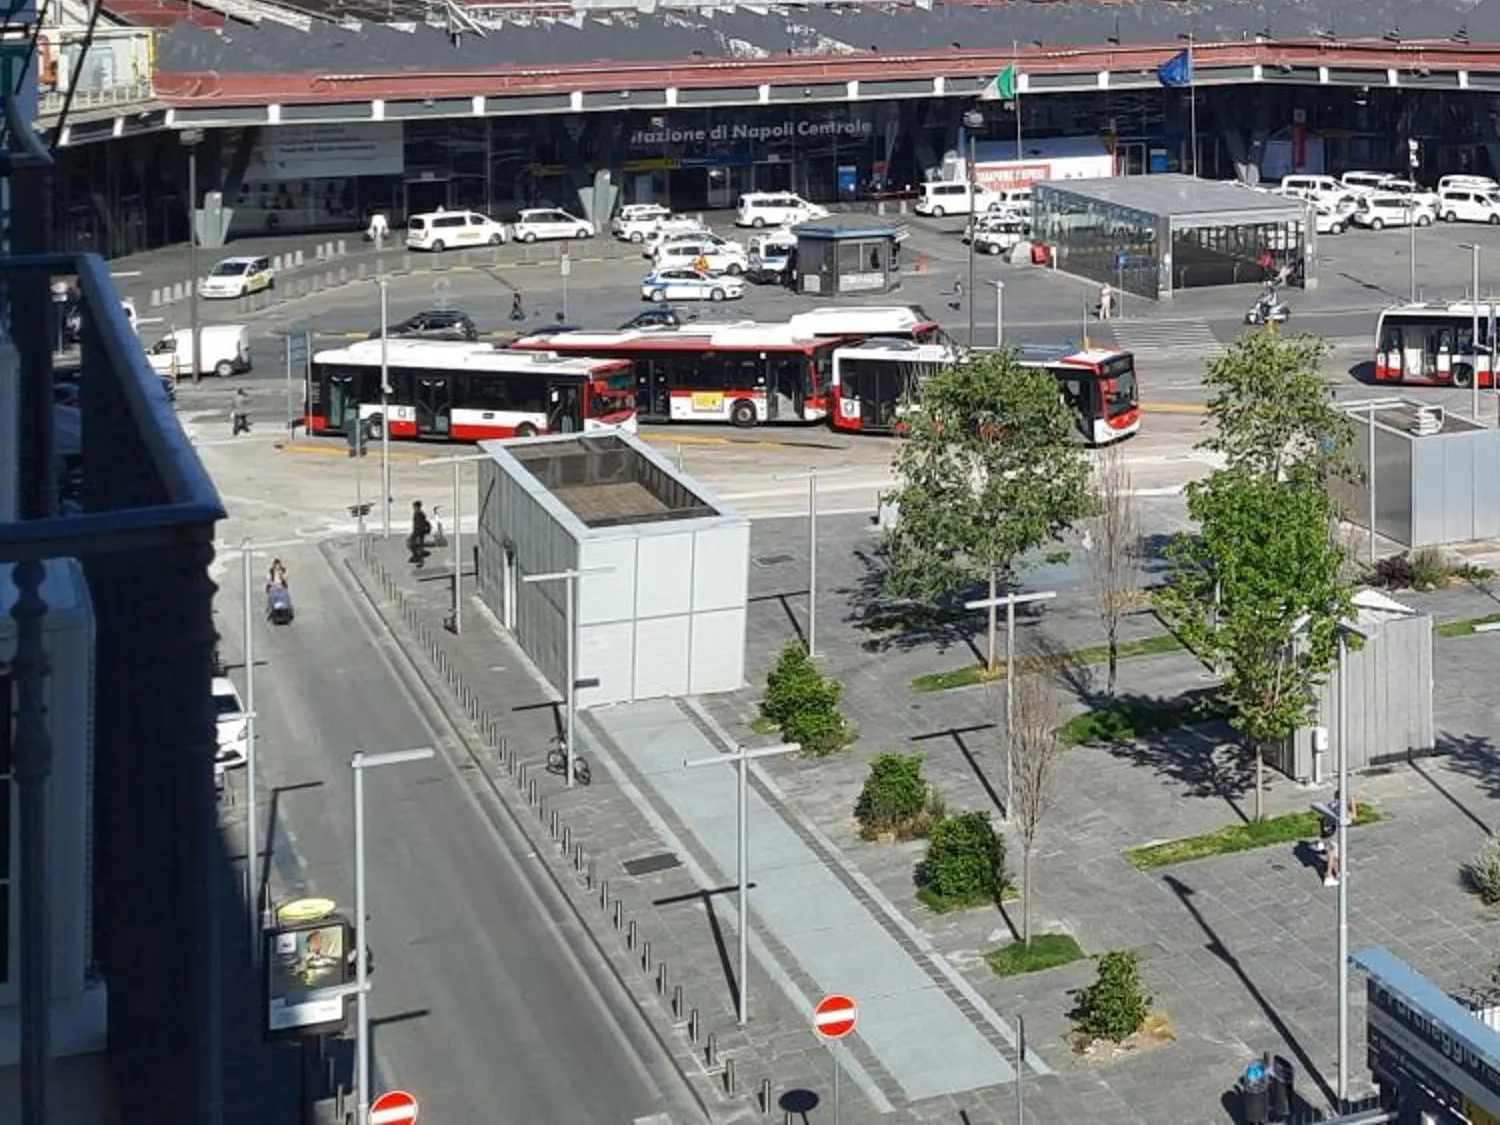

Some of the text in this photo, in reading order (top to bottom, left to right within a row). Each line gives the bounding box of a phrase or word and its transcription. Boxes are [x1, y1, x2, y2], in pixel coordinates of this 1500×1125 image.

[631, 119, 872, 144] tazione di Napoli Centrale
